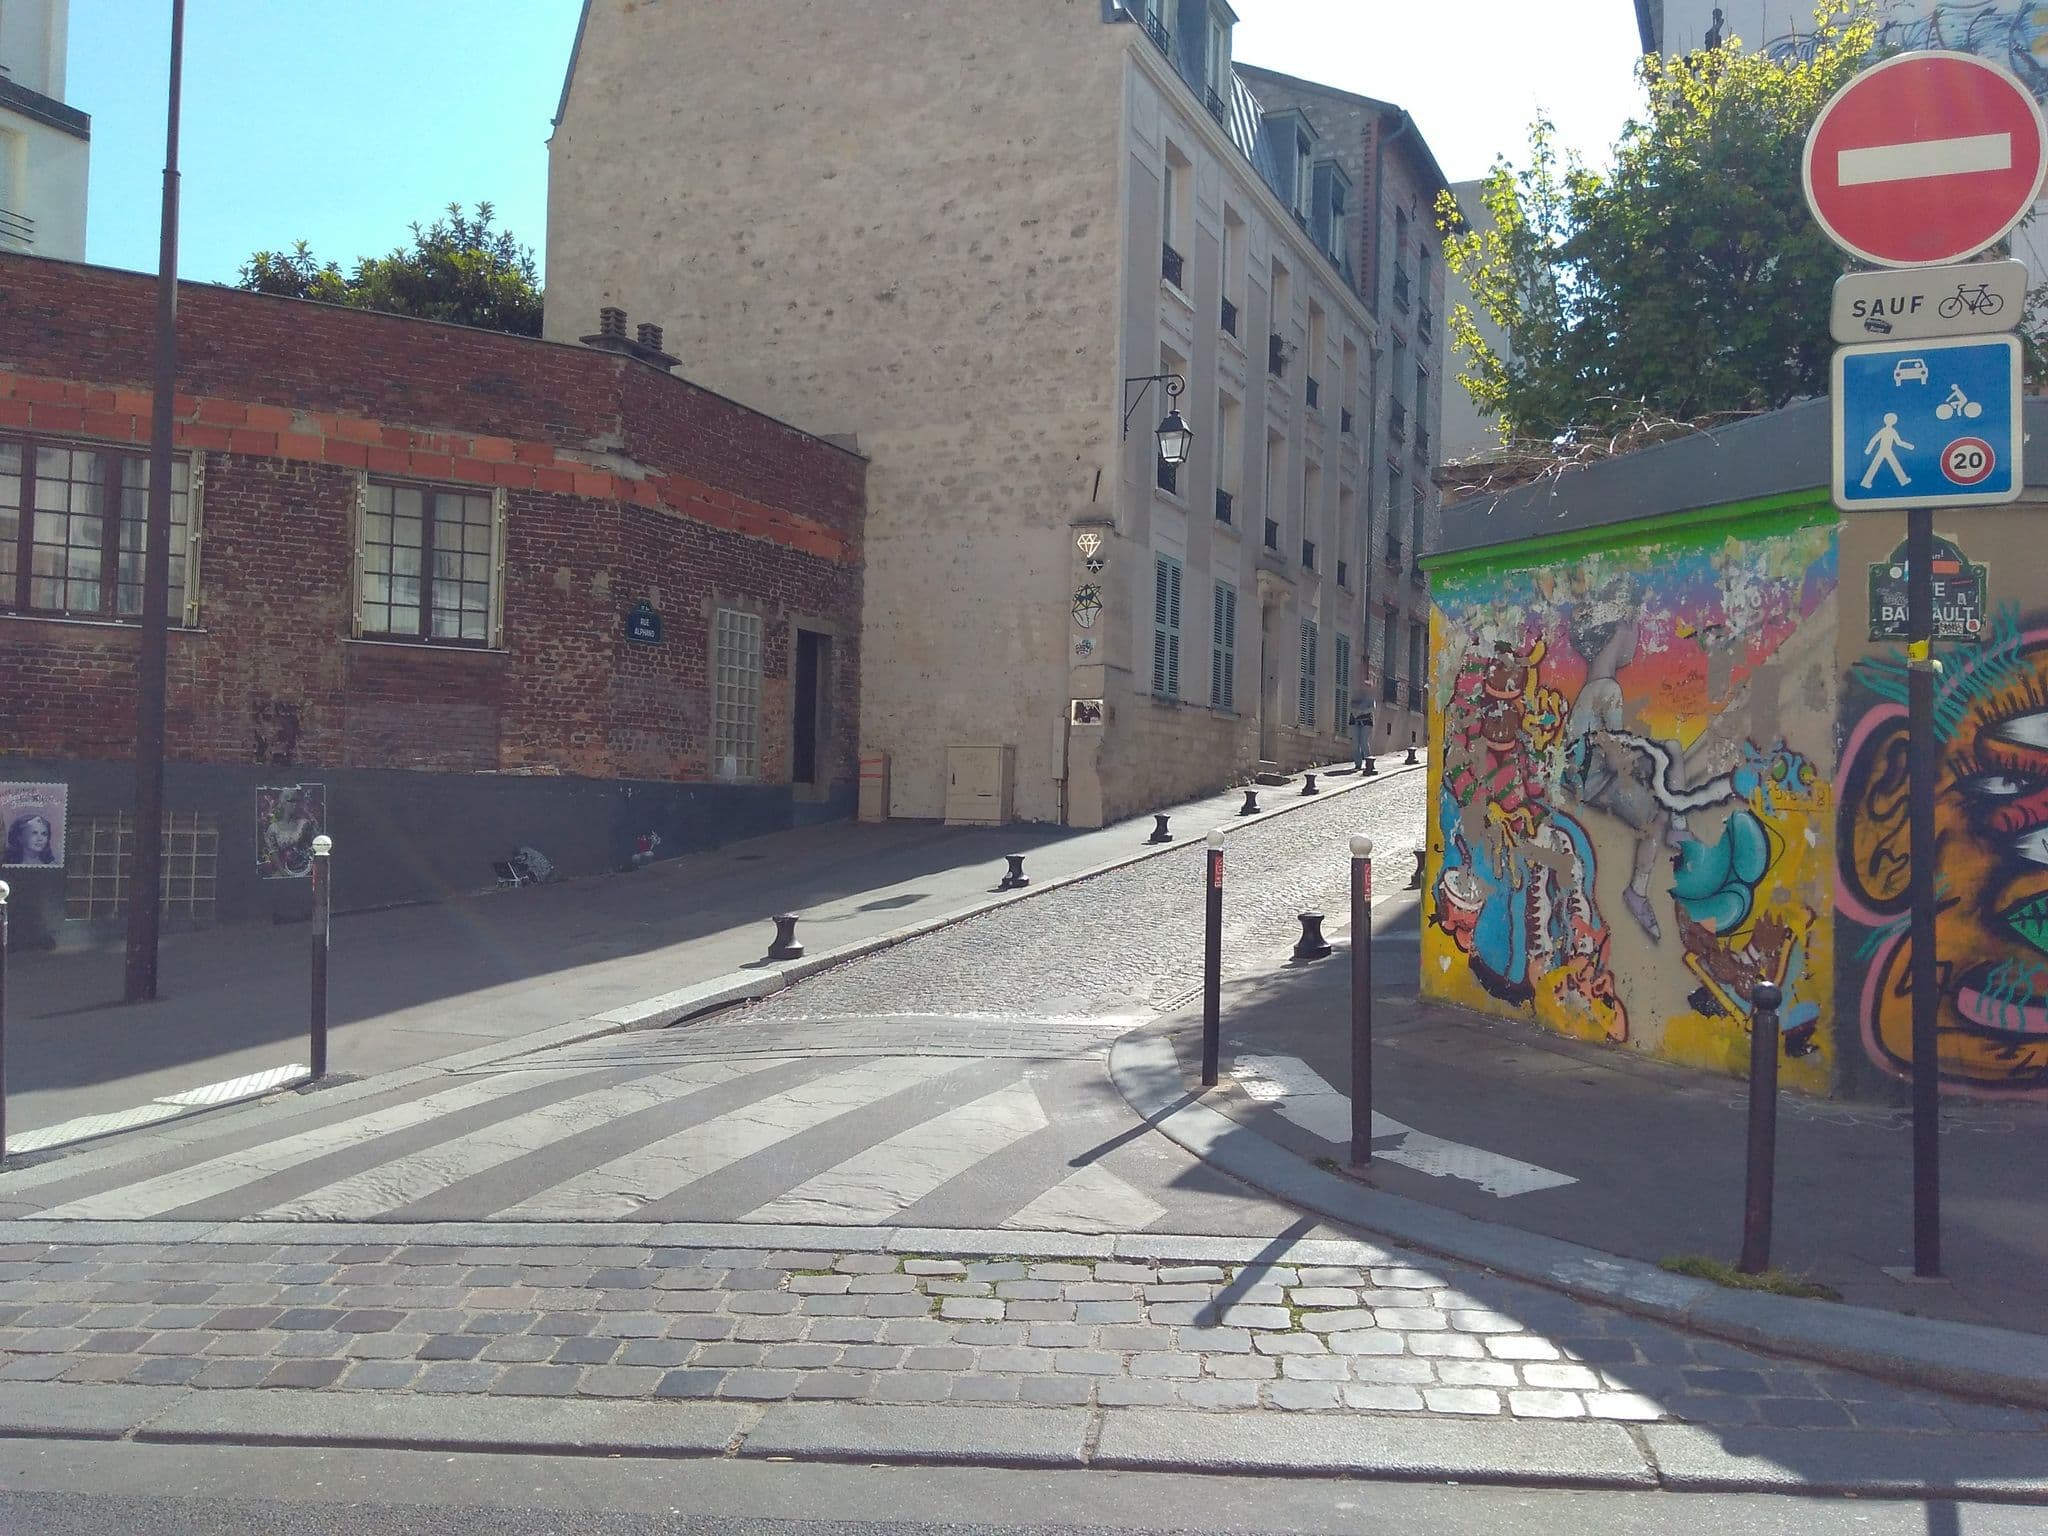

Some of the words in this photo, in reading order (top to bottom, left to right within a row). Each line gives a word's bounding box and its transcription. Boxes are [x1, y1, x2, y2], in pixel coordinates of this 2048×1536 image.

[1851, 295, 1925, 319] SAUF
[1953, 452, 1983, 470] 20
[640, 617, 650, 627] RUE
[1881, 606, 1975, 622] BAAULT
[634, 627, 655, 638] ALPHAND
